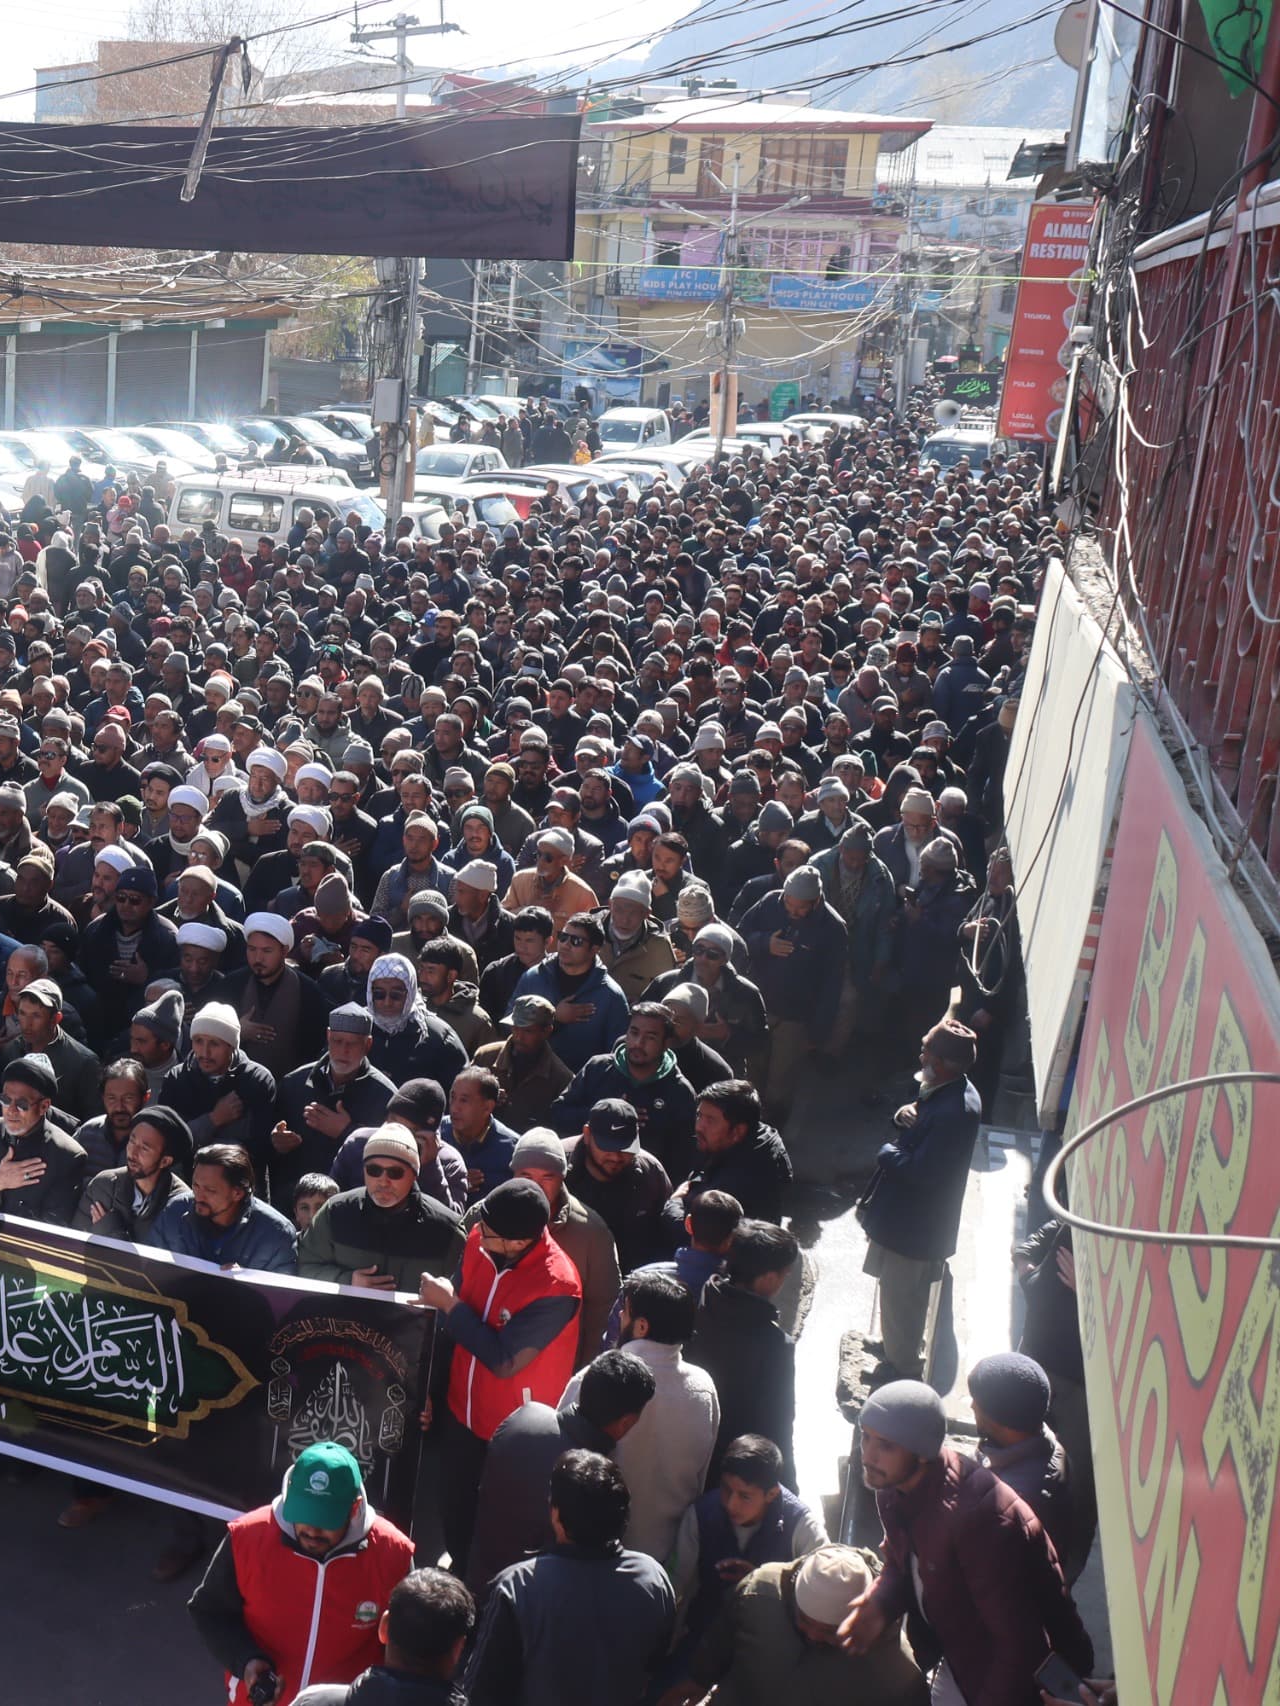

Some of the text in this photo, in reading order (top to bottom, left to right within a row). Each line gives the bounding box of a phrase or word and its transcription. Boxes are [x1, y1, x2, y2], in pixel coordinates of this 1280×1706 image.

[1043, 223, 1091, 239] ALMAD
[669, 281, 692, 290] PLAY
[695, 283, 721, 291] HOU
[803, 291, 827, 300] PLAY
